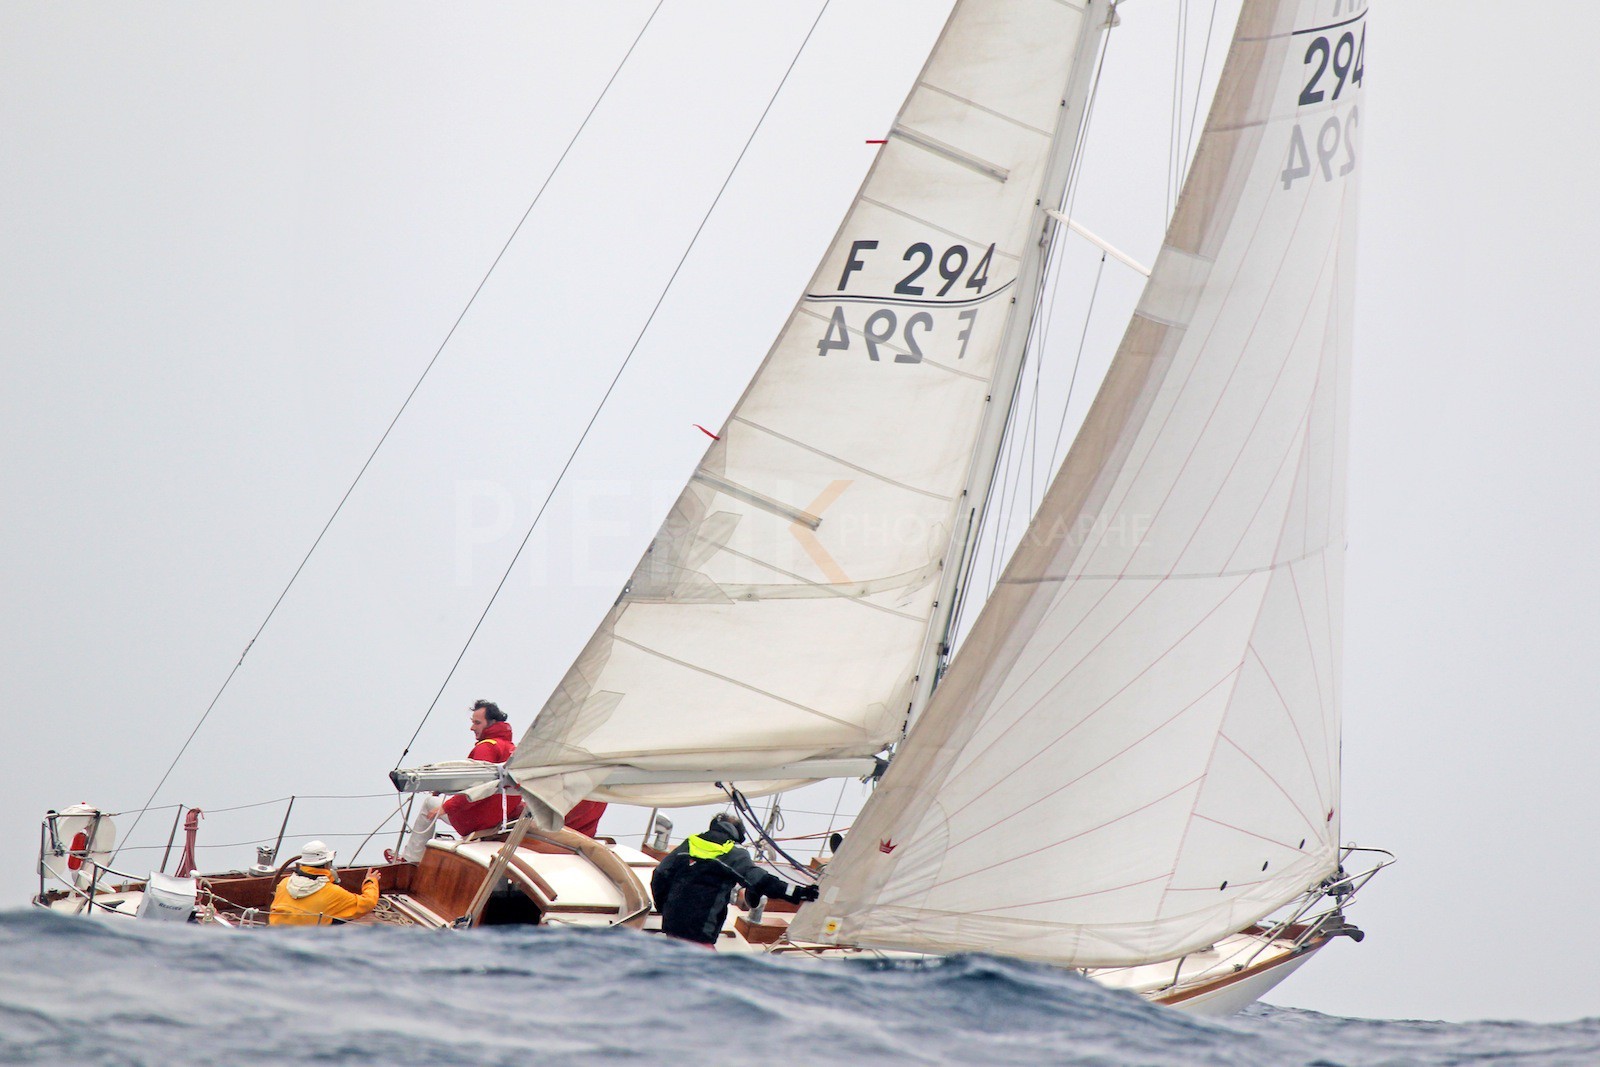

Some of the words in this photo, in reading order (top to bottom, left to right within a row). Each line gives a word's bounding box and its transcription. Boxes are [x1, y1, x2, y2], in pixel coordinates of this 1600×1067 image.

[1298, 20, 1366, 106] 294
[837, 240, 879, 291] F
[893, 242, 996, 297] 294
